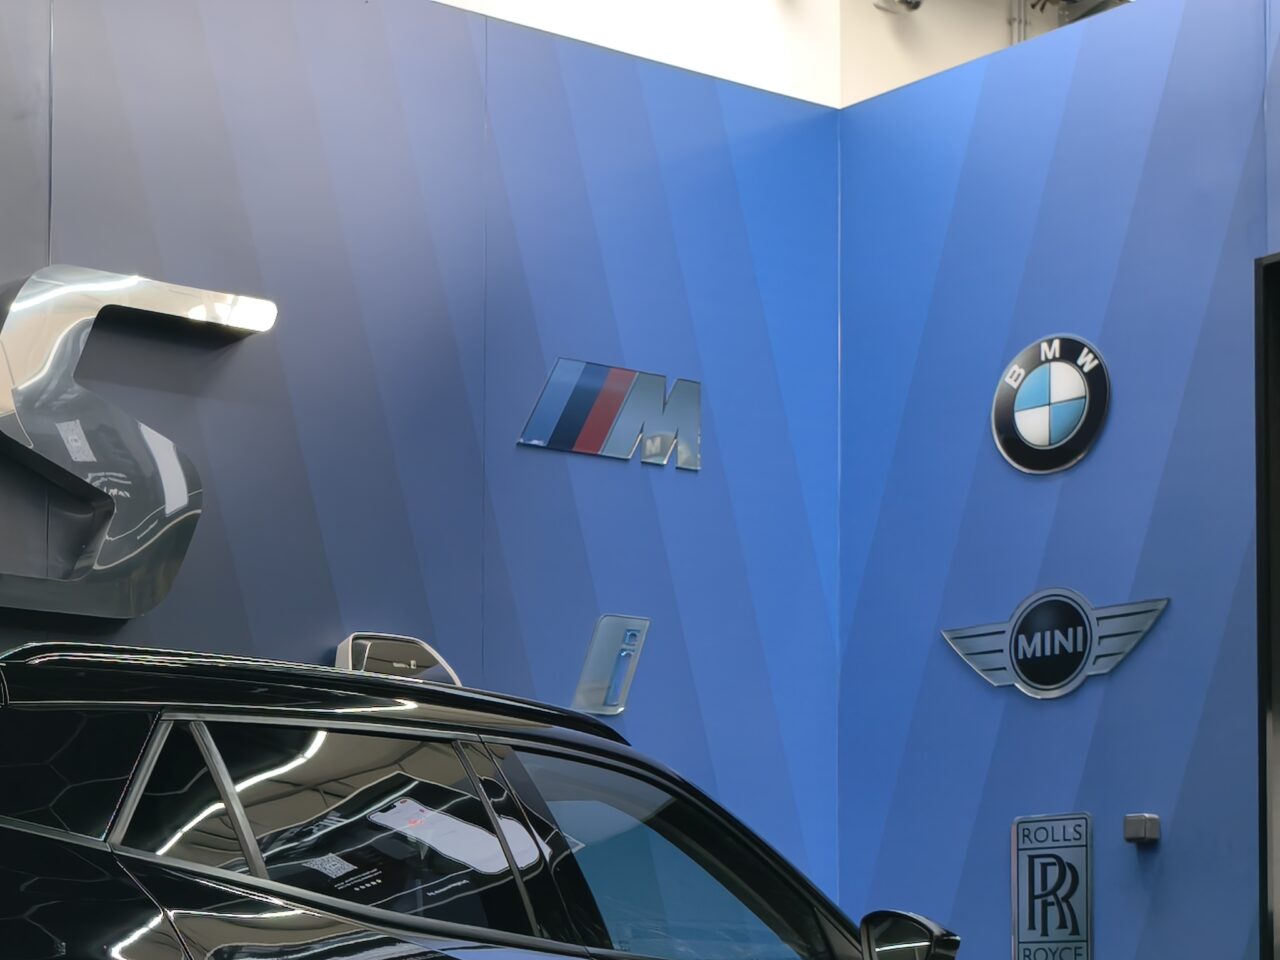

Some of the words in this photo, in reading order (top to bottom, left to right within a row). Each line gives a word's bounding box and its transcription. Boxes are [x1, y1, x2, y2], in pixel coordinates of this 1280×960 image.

[1004, 338, 1100, 390] BMW
[599, 371, 702, 472] M
[1018, 626, 1083, 659] MINI
[1022, 824, 1082, 844] ROLLS
[1027, 853, 1081, 937] RR
